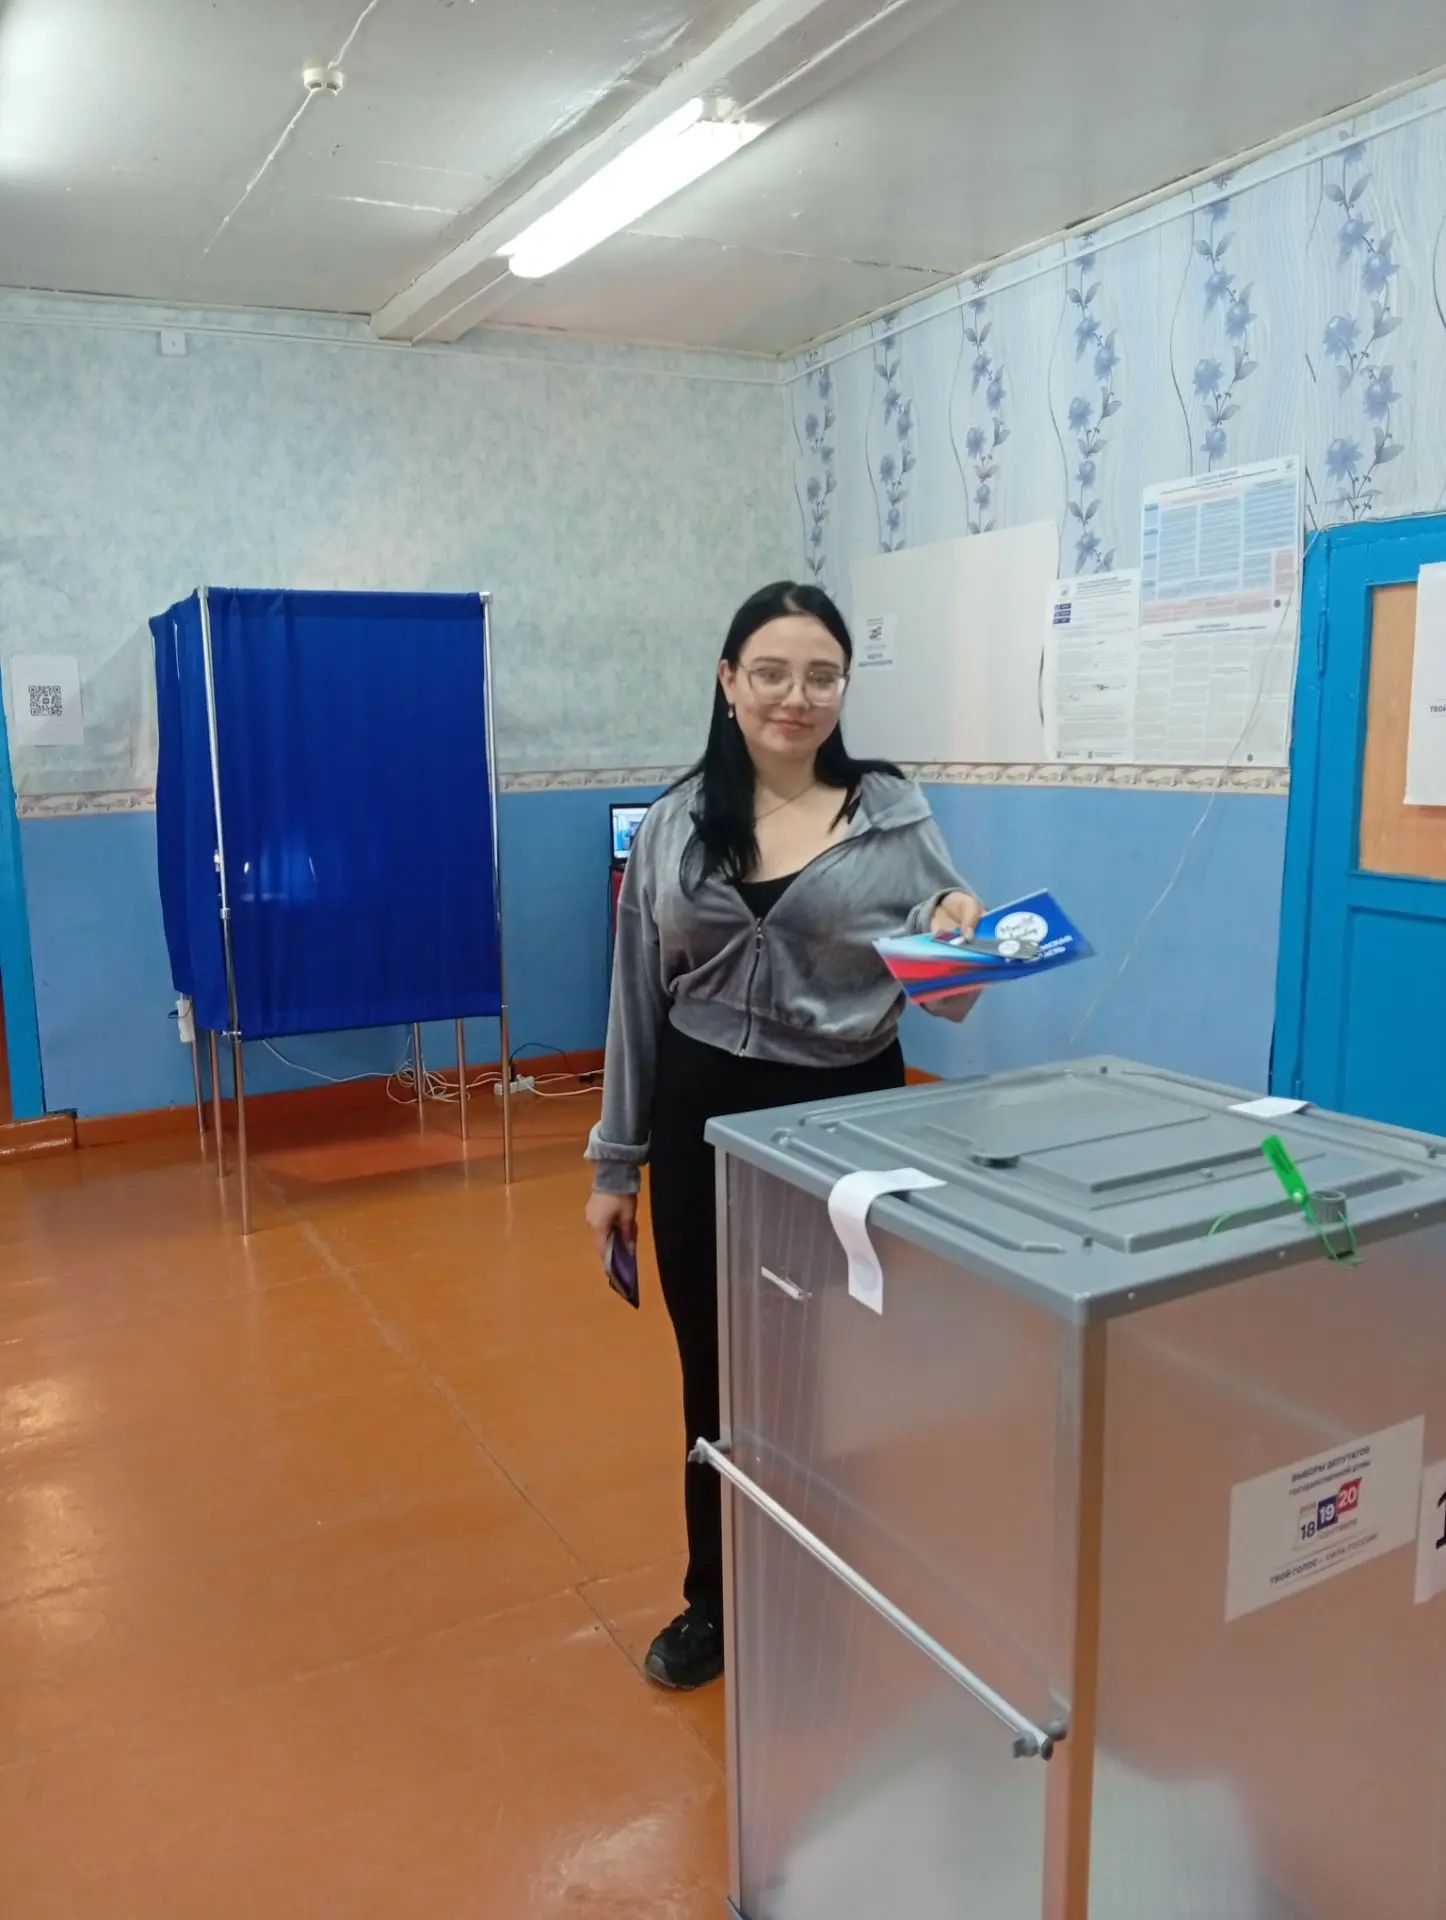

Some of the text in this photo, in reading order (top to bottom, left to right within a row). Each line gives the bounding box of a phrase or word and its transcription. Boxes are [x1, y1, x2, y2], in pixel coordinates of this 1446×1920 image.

[1291, 1446, 1370, 1482] ВЫБОРЫ ДЕПУТАТОВ
[1301, 1521, 1315, 1540] 18
[1319, 1504, 1335, 1523] 19
[1338, 1486, 1357, 1507] 20
[1269, 1569, 1290, 1585] ТВОЙ
